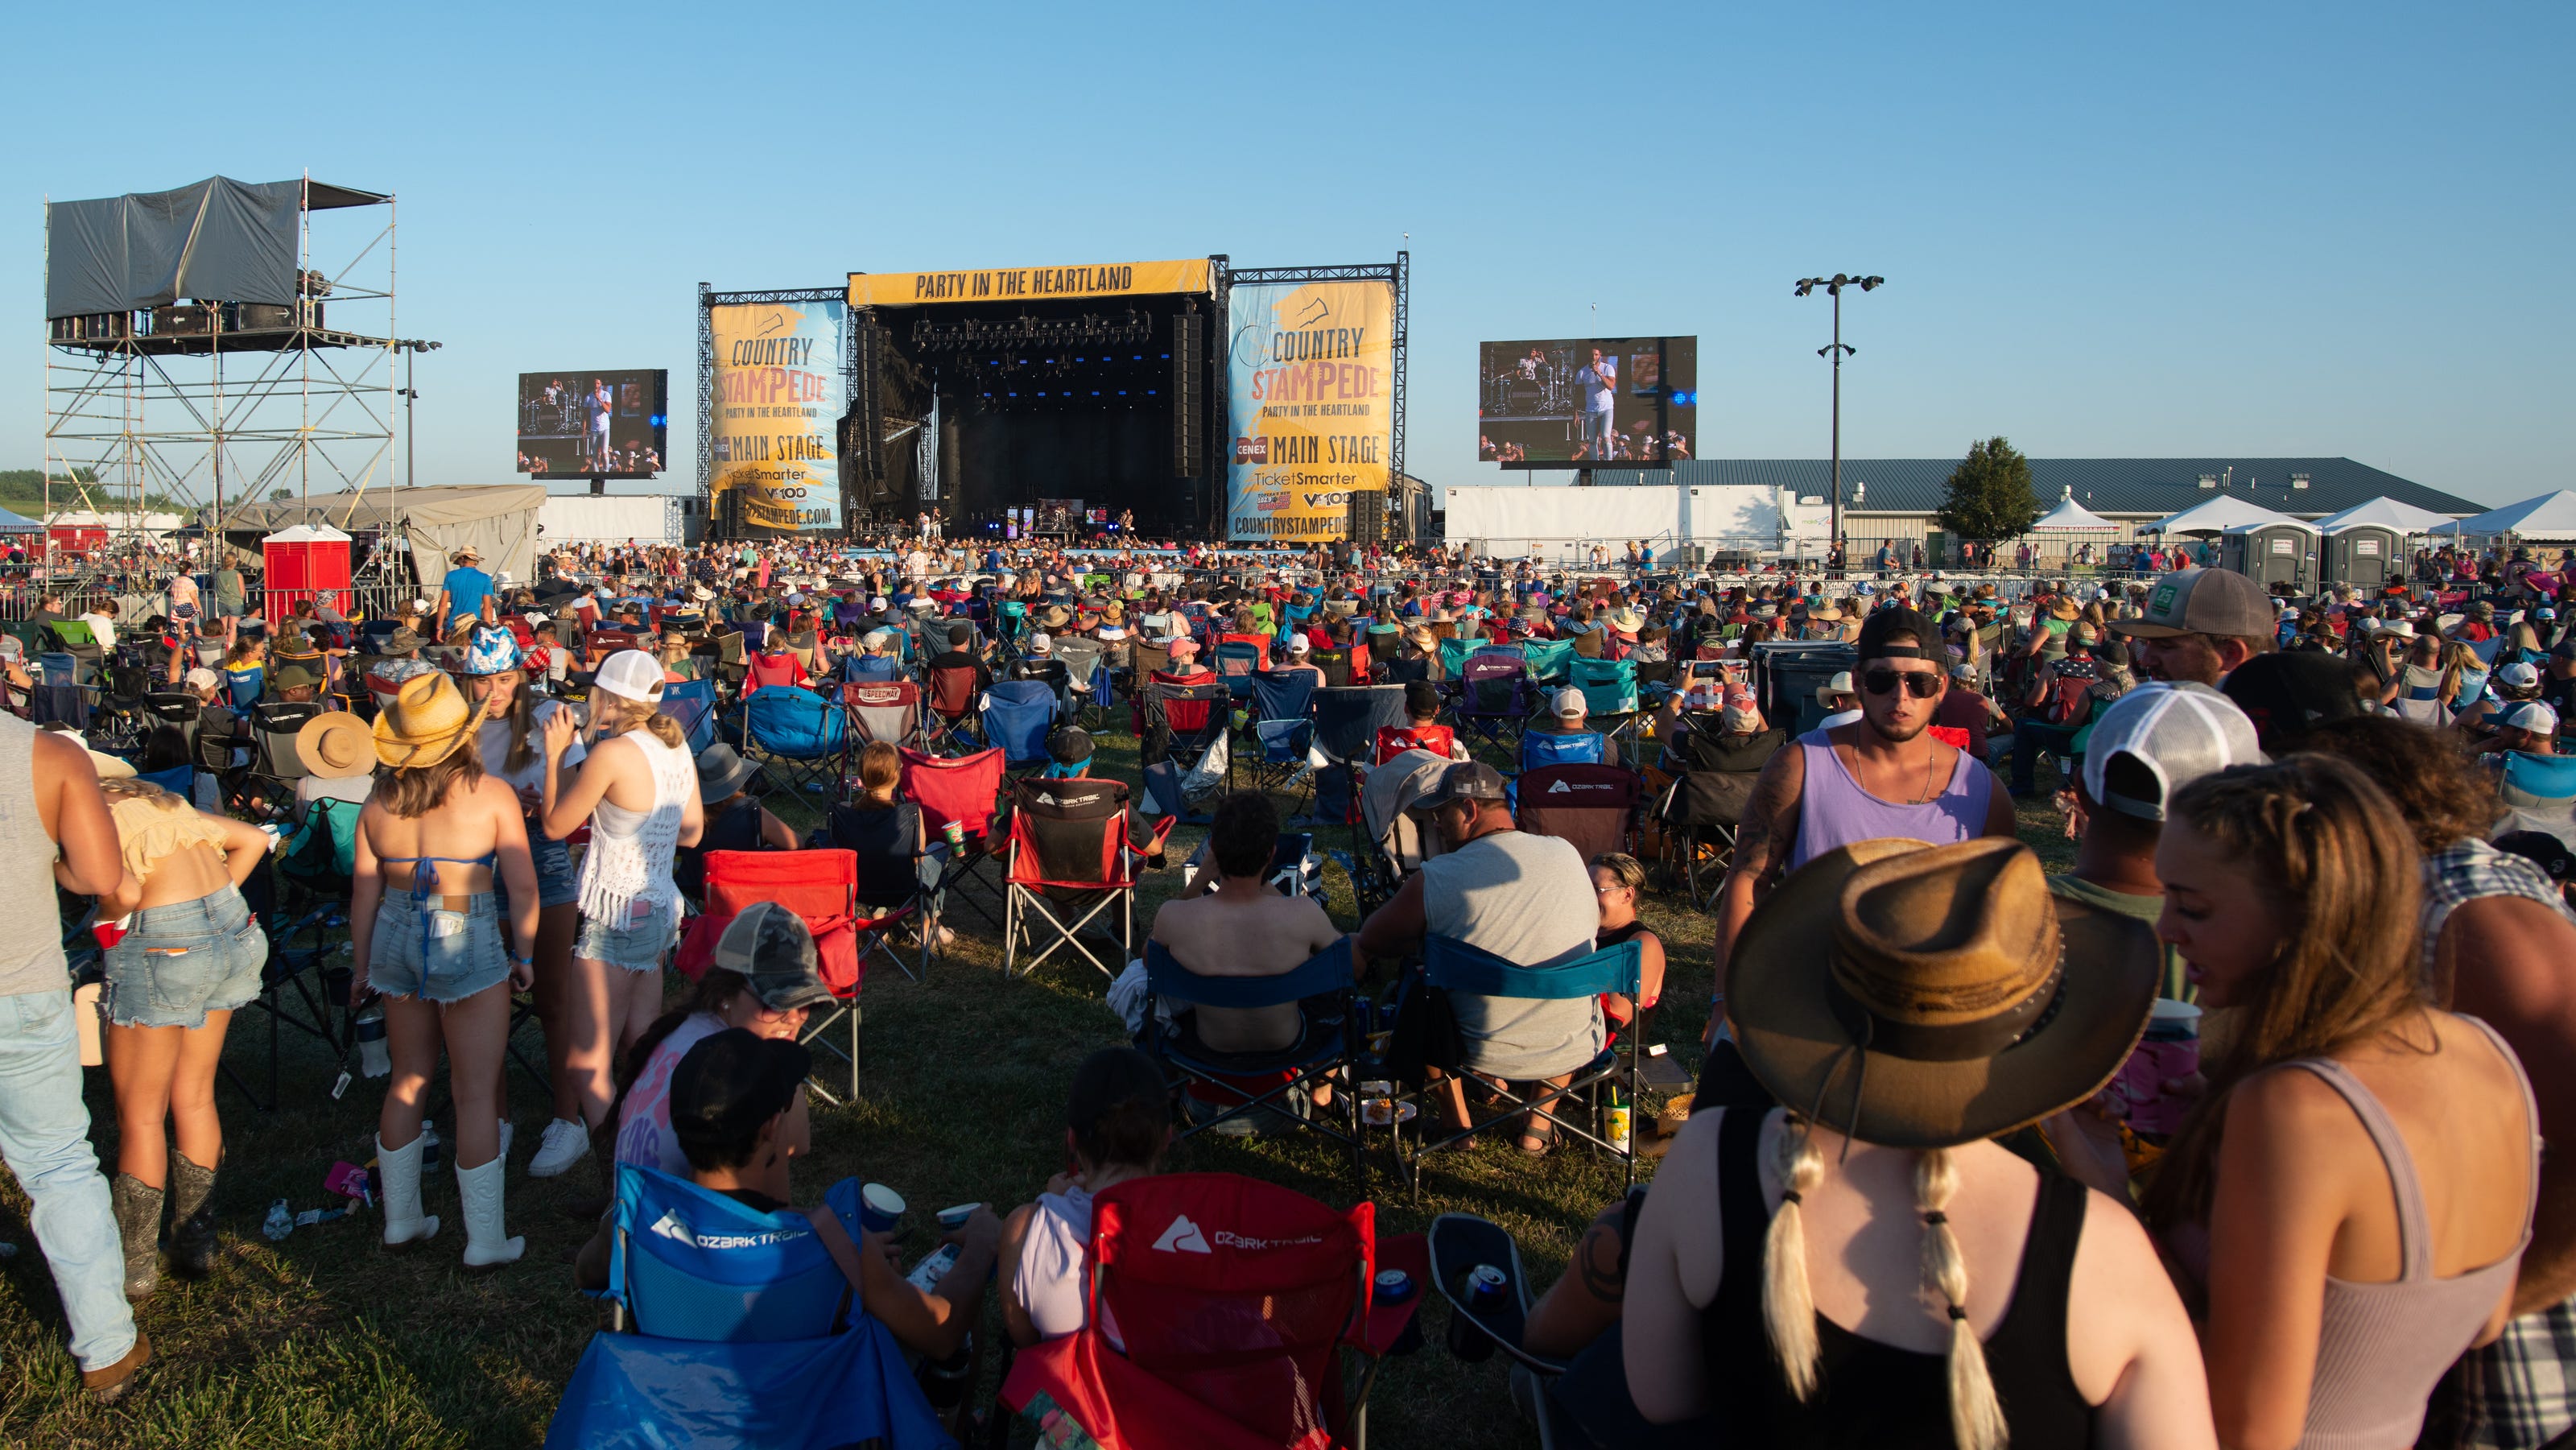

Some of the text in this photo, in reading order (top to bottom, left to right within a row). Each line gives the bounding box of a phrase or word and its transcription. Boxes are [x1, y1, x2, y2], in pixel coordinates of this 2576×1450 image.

[915, 266, 1132, 299] PARTY IN THE HEARTLAND
[732, 338, 814, 366] COUNTRY
[1273, 328, 1364, 362] COUNTRY
[719, 367, 827, 403] STAMPEDE
[1252, 361, 1380, 401] STAMPEDE
[725, 407, 817, 419] PARTY IN THE HEARTLAND
[1262, 404, 1370, 418] PARTY IN THE HEARTLAND
[733, 435, 824, 461] MAIN STAGE
[1237, 444, 1266, 455] CENEX
[1274, 435, 1379, 465] MAIN STAGE
[725, 469, 807, 481] TicketSmarter
[1255, 473, 1357, 485] TicketSmarter
[2157, 589, 2174, 603] 25
[867, 689, 898, 697] SPEEDWAY
